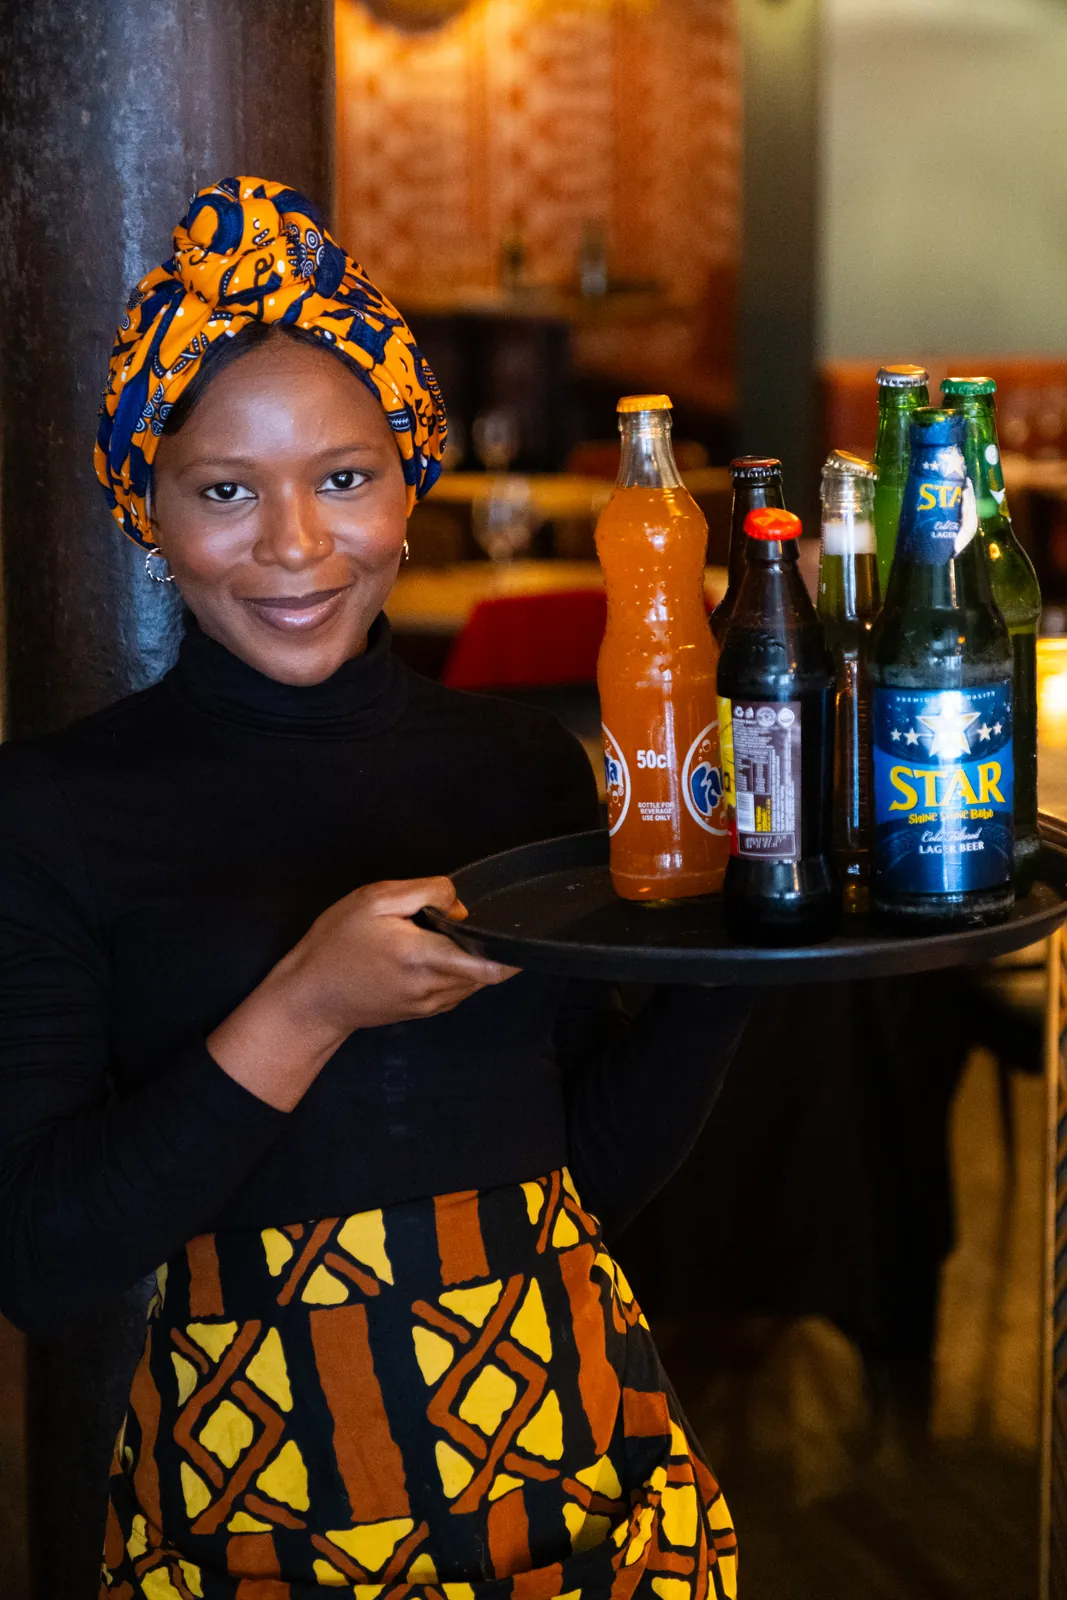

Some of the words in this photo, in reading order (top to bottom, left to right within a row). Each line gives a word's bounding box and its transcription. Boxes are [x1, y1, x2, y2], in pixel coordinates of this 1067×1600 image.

[917, 483, 962, 511] STA
[964, 690, 996, 701] UALITY
[889, 761, 1006, 811] STAR
[919, 844, 957, 854] LAGER
[959, 841, 985, 851] BEER
